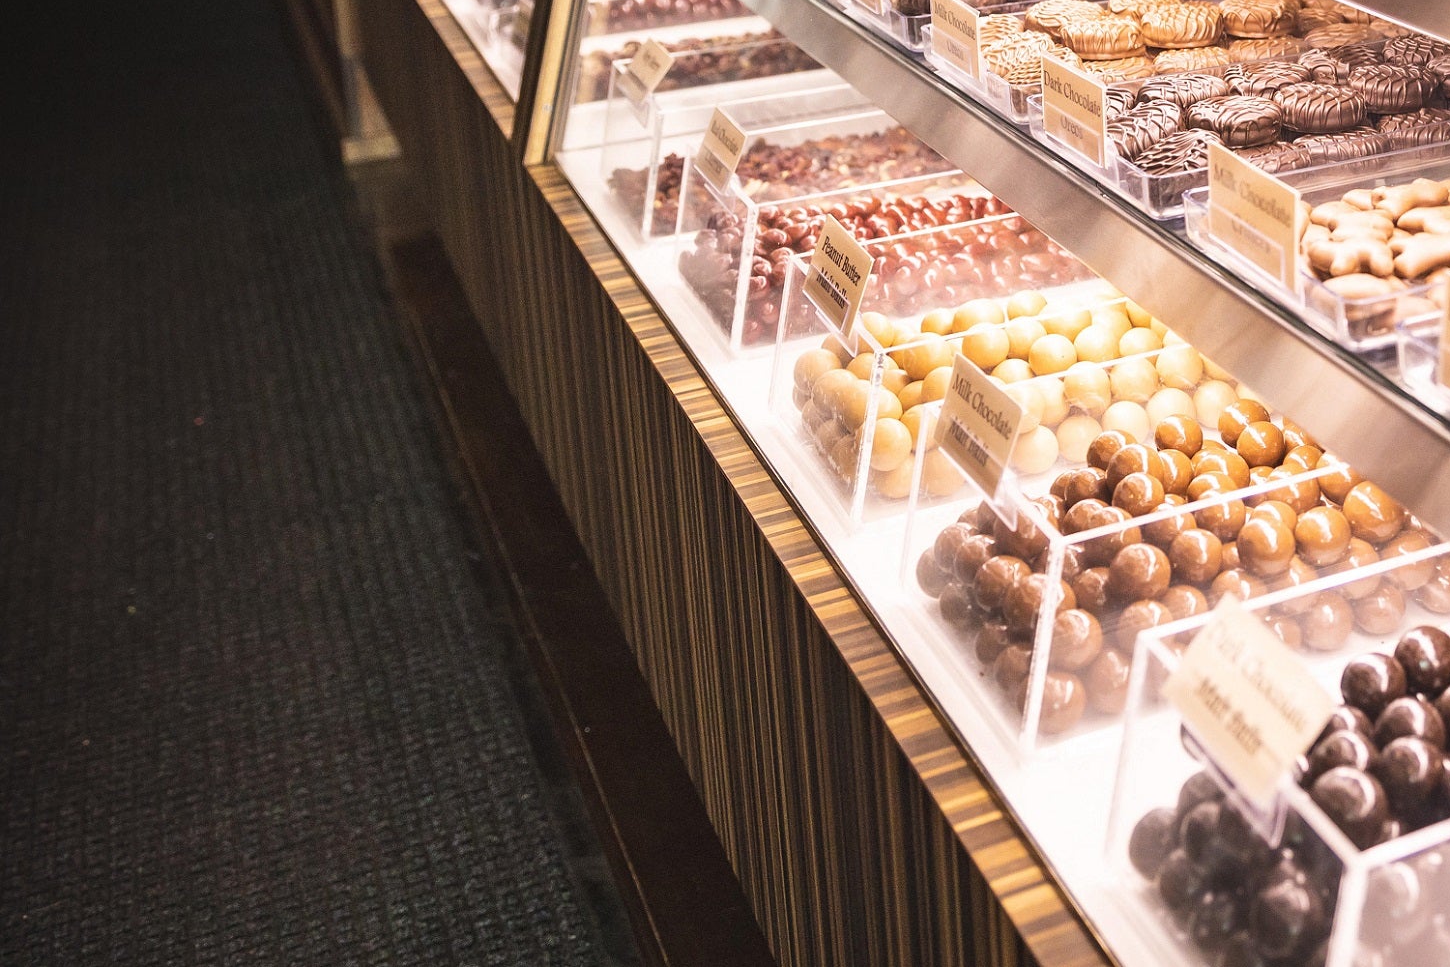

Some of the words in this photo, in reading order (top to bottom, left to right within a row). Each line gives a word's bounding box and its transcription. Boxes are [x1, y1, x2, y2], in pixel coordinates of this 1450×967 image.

[934, 1, 948, 21] Milk
[947, 10, 976, 41] Chocolate
[1044, 70, 1063, 93] Dark
[1063, 82, 1101, 117] Chocolate
[1060, 115, 1084, 139] Oreos
[1238, 180, 1292, 229] Chocolate
[821, 235, 845, 269] Peanut
[843, 256, 861, 287] Butter
[952, 373, 972, 404] Milk
[970, 392, 1013, 440] Chocolate
